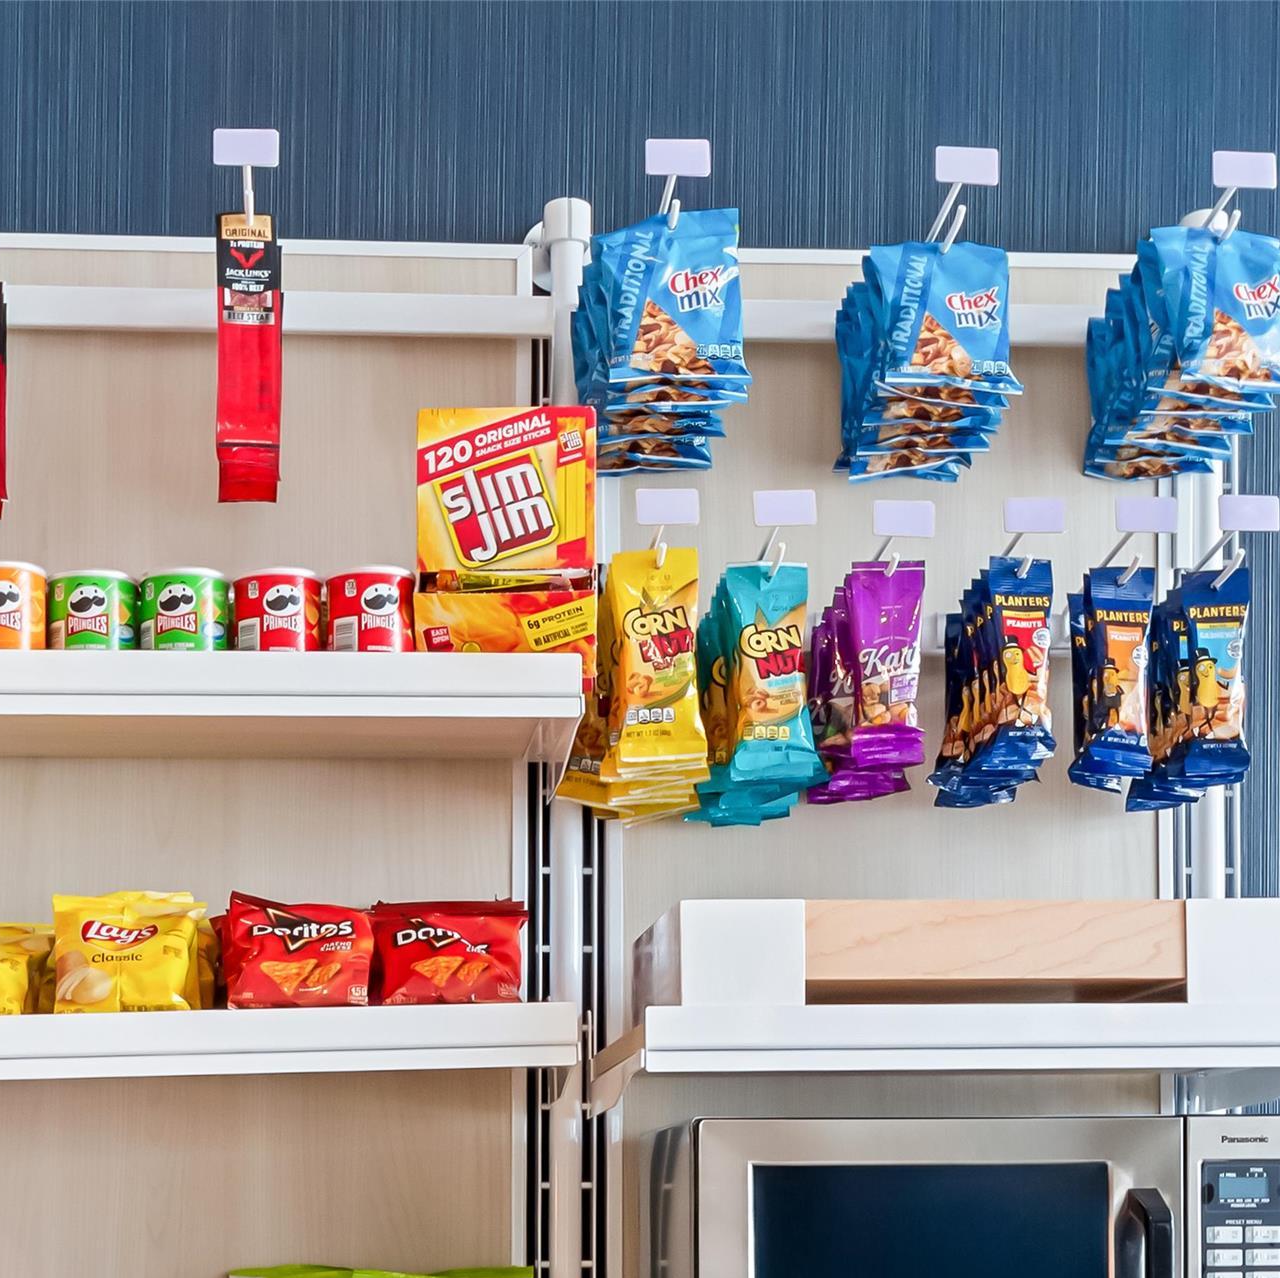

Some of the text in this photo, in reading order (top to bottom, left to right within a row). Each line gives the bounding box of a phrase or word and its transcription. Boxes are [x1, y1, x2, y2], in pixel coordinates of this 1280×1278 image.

[225, 228, 269, 239] ORIGINAL
[225, 268, 244, 277] JACK
[670, 267, 721, 294] Chex
[948, 288, 996, 310] Chex
[1234, 277, 1280, 301] Chex
[679, 288, 722, 312] mix
[893, 255, 928, 351] TRADITIONAL
[957, 304, 999, 327] mix
[424, 413, 552, 475] 120 ORIGINAL
[475, 427, 551, 458] SNACK SIZE STICKS
[441, 463, 544, 524] slim
[994, 594, 1050, 608] PLANTERS
[527, 619, 541, 630] 6g
[542, 605, 583, 624] PROTEIN
[1096, 609, 1149, 624] PLANTERS
[1189, 605, 1246, 619] PLANTERS
[68, 614, 108, 635] PRINGLES
[157, 613, 196, 634] PRINGLES
[263, 614, 301, 632] PRINGLES
[431, 628, 448, 637] EASY
[623, 605, 688, 641] CORN
[1006, 619, 1043, 628] PEANUTS
[533, 637, 543, 647] NO
[739, 624, 802, 660] CORN
[85, 920, 155, 945] Lay's
[252, 920, 353, 938] Doritos
[91, 952, 143, 963] Classic
[1221, 1135, 1269, 1143] Panasonic
